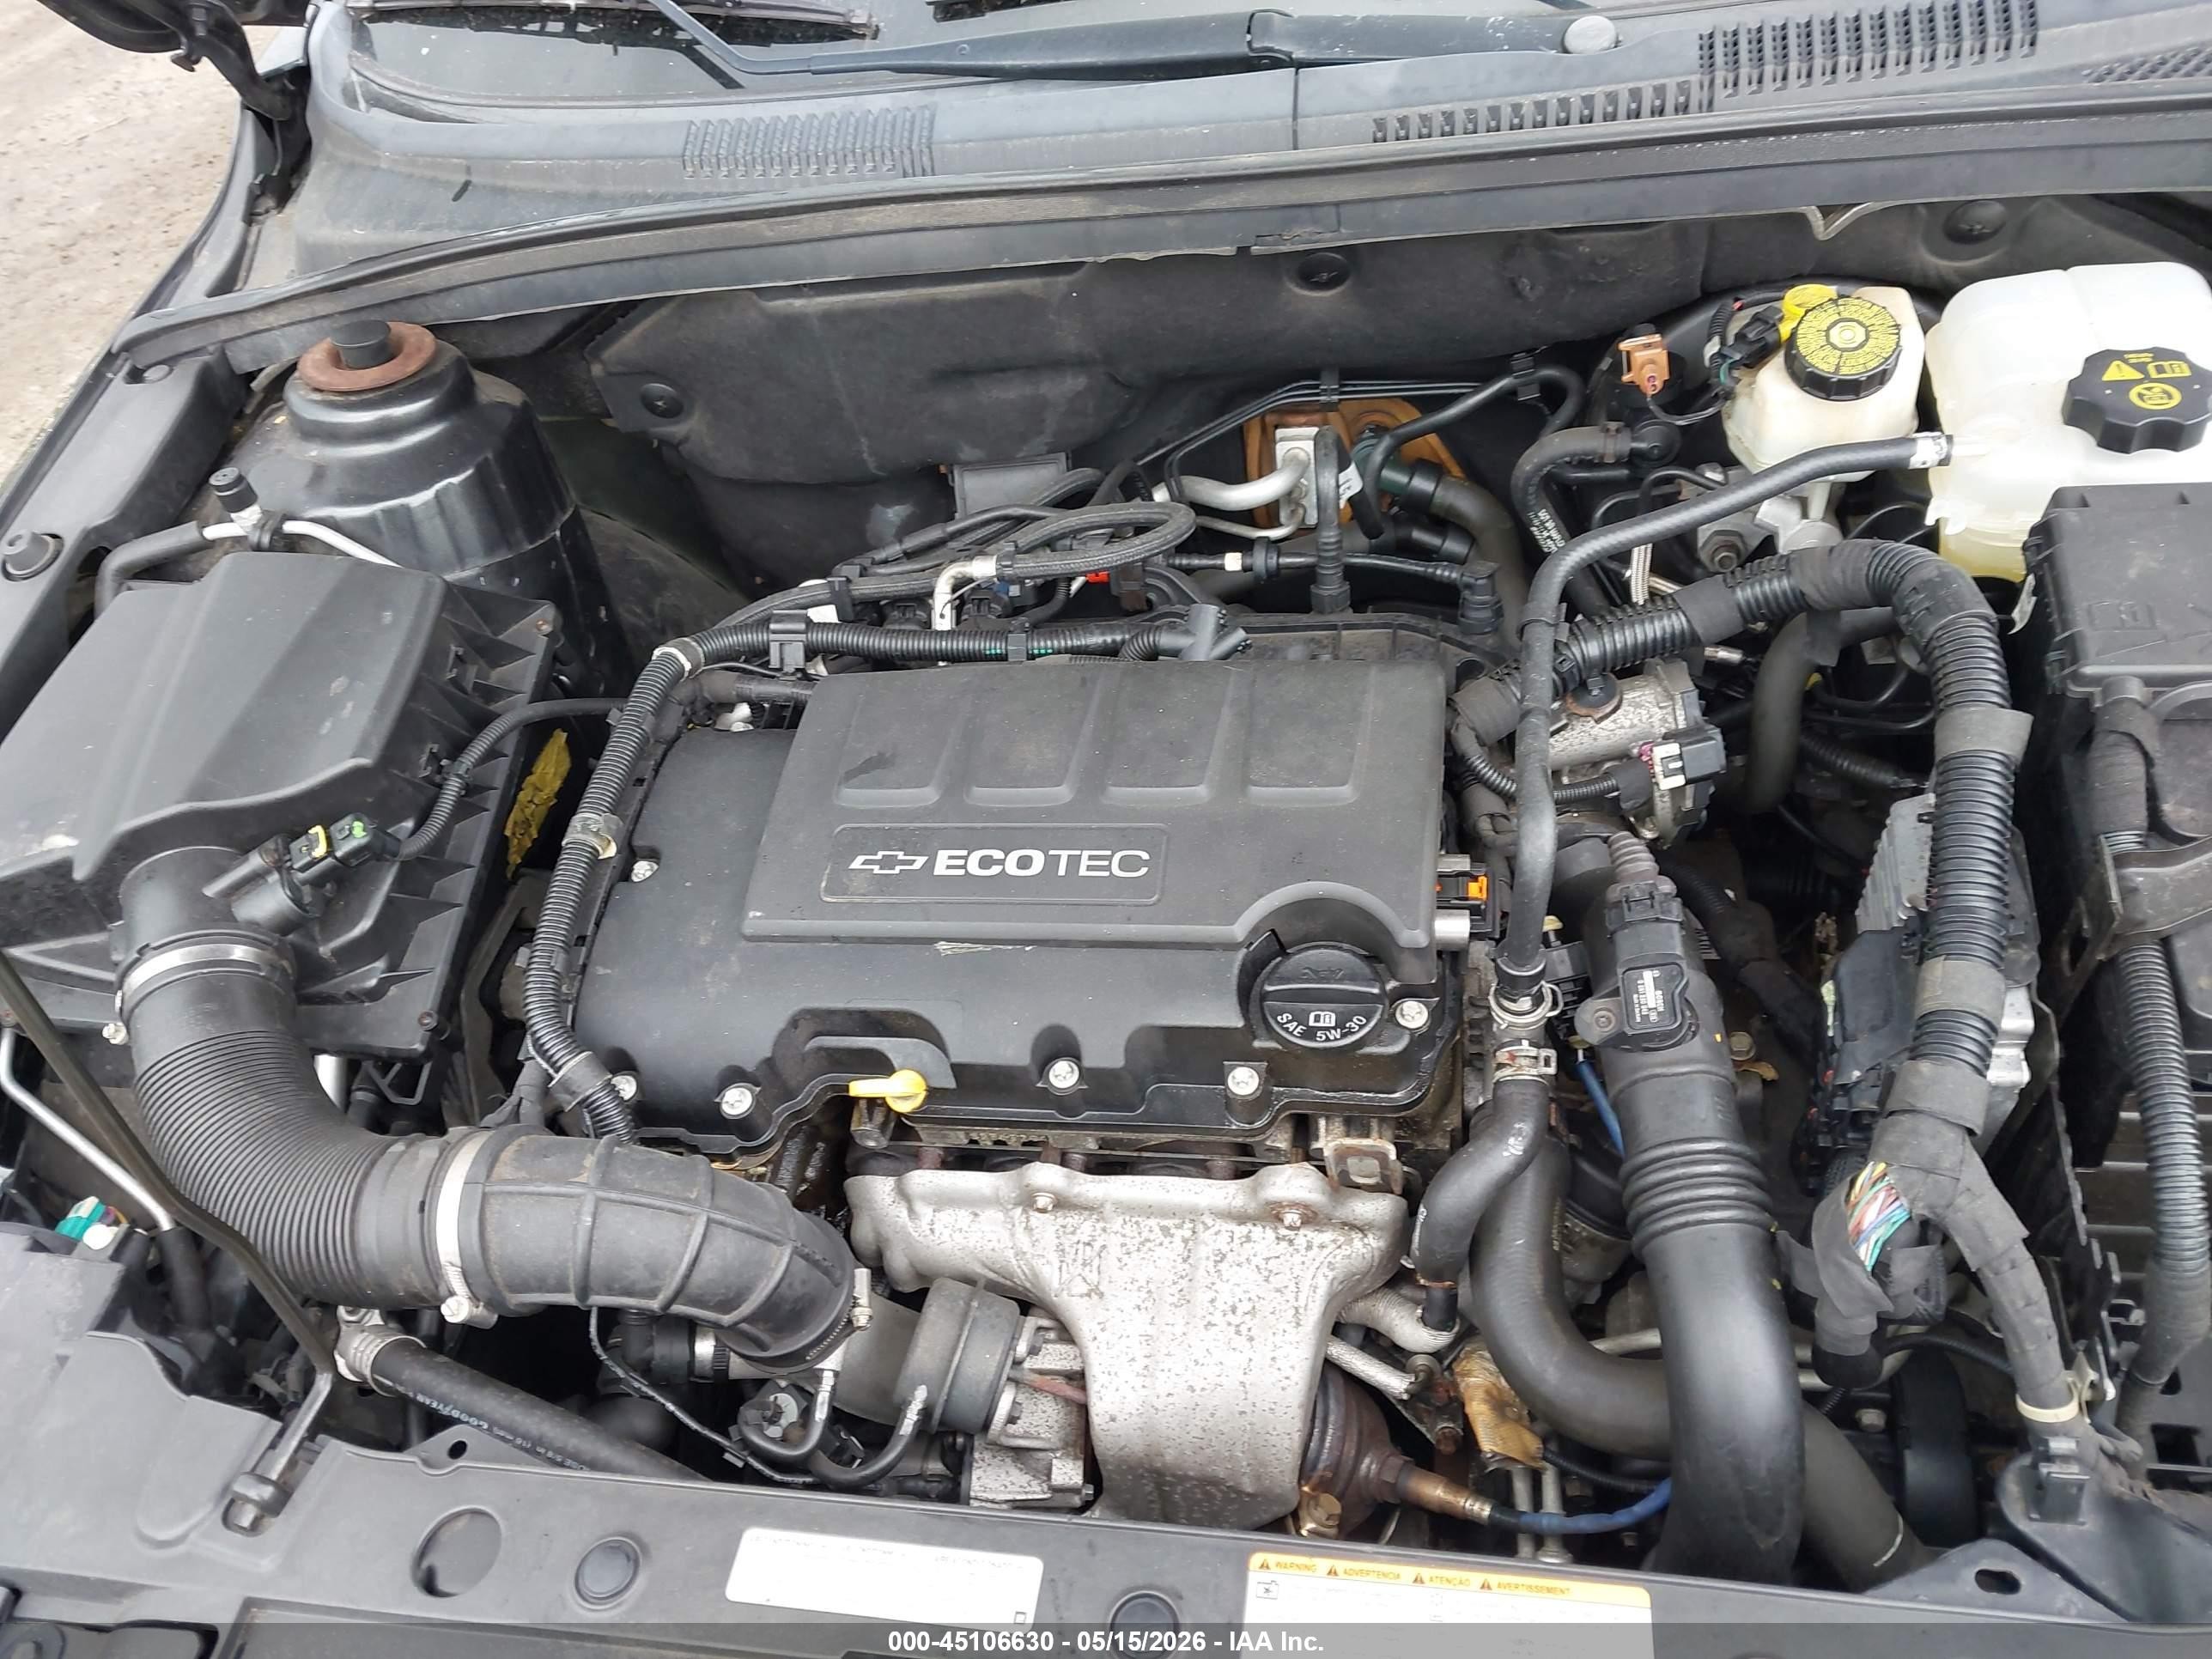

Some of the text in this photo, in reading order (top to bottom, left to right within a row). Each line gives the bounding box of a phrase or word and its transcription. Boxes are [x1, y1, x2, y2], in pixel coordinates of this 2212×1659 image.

[933, 848, 1152, 878] ECOTEC
[1277, 1013, 1367, 1041] SAE 5W-30
[416, 1392, 489, 1430] GOODYEAR
[1275, 1561, 1316, 1573] WARNING
[1497, 1581, 1571, 1596] AVERTISSEMENT
